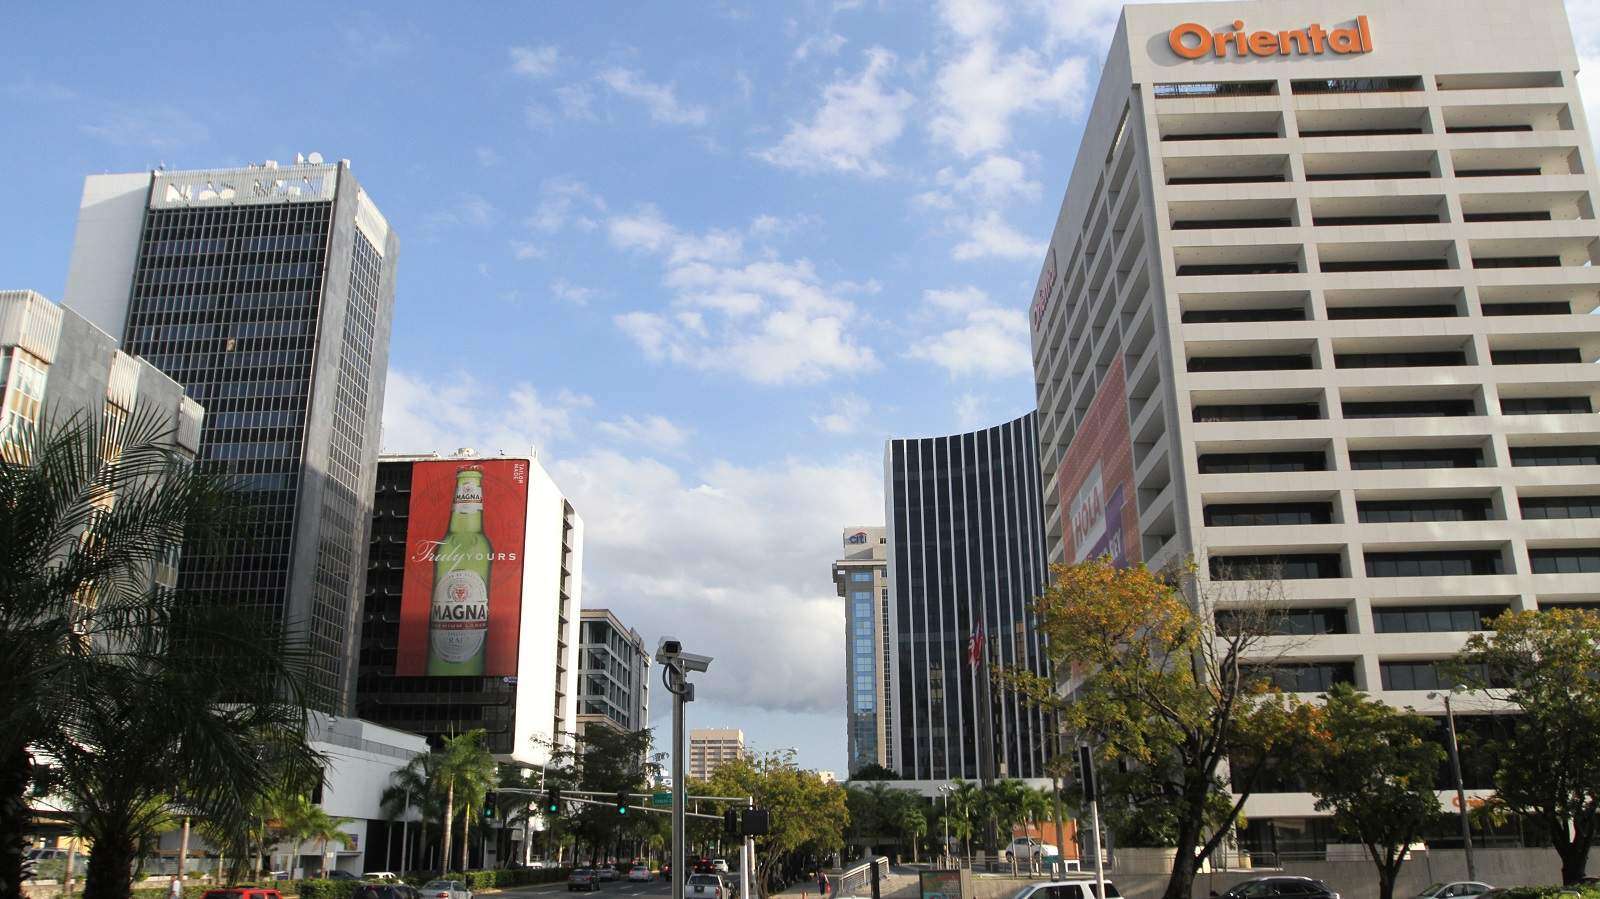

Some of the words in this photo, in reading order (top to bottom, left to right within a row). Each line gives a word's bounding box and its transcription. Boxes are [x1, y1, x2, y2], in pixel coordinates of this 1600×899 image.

[1168, 15, 1373, 59] Oriental
[1072, 485, 1102, 547] HOLA
[412, 539, 465, 573] Truly
[465, 552, 517, 561] YOURS
[432, 604, 486, 620] MAGNA
